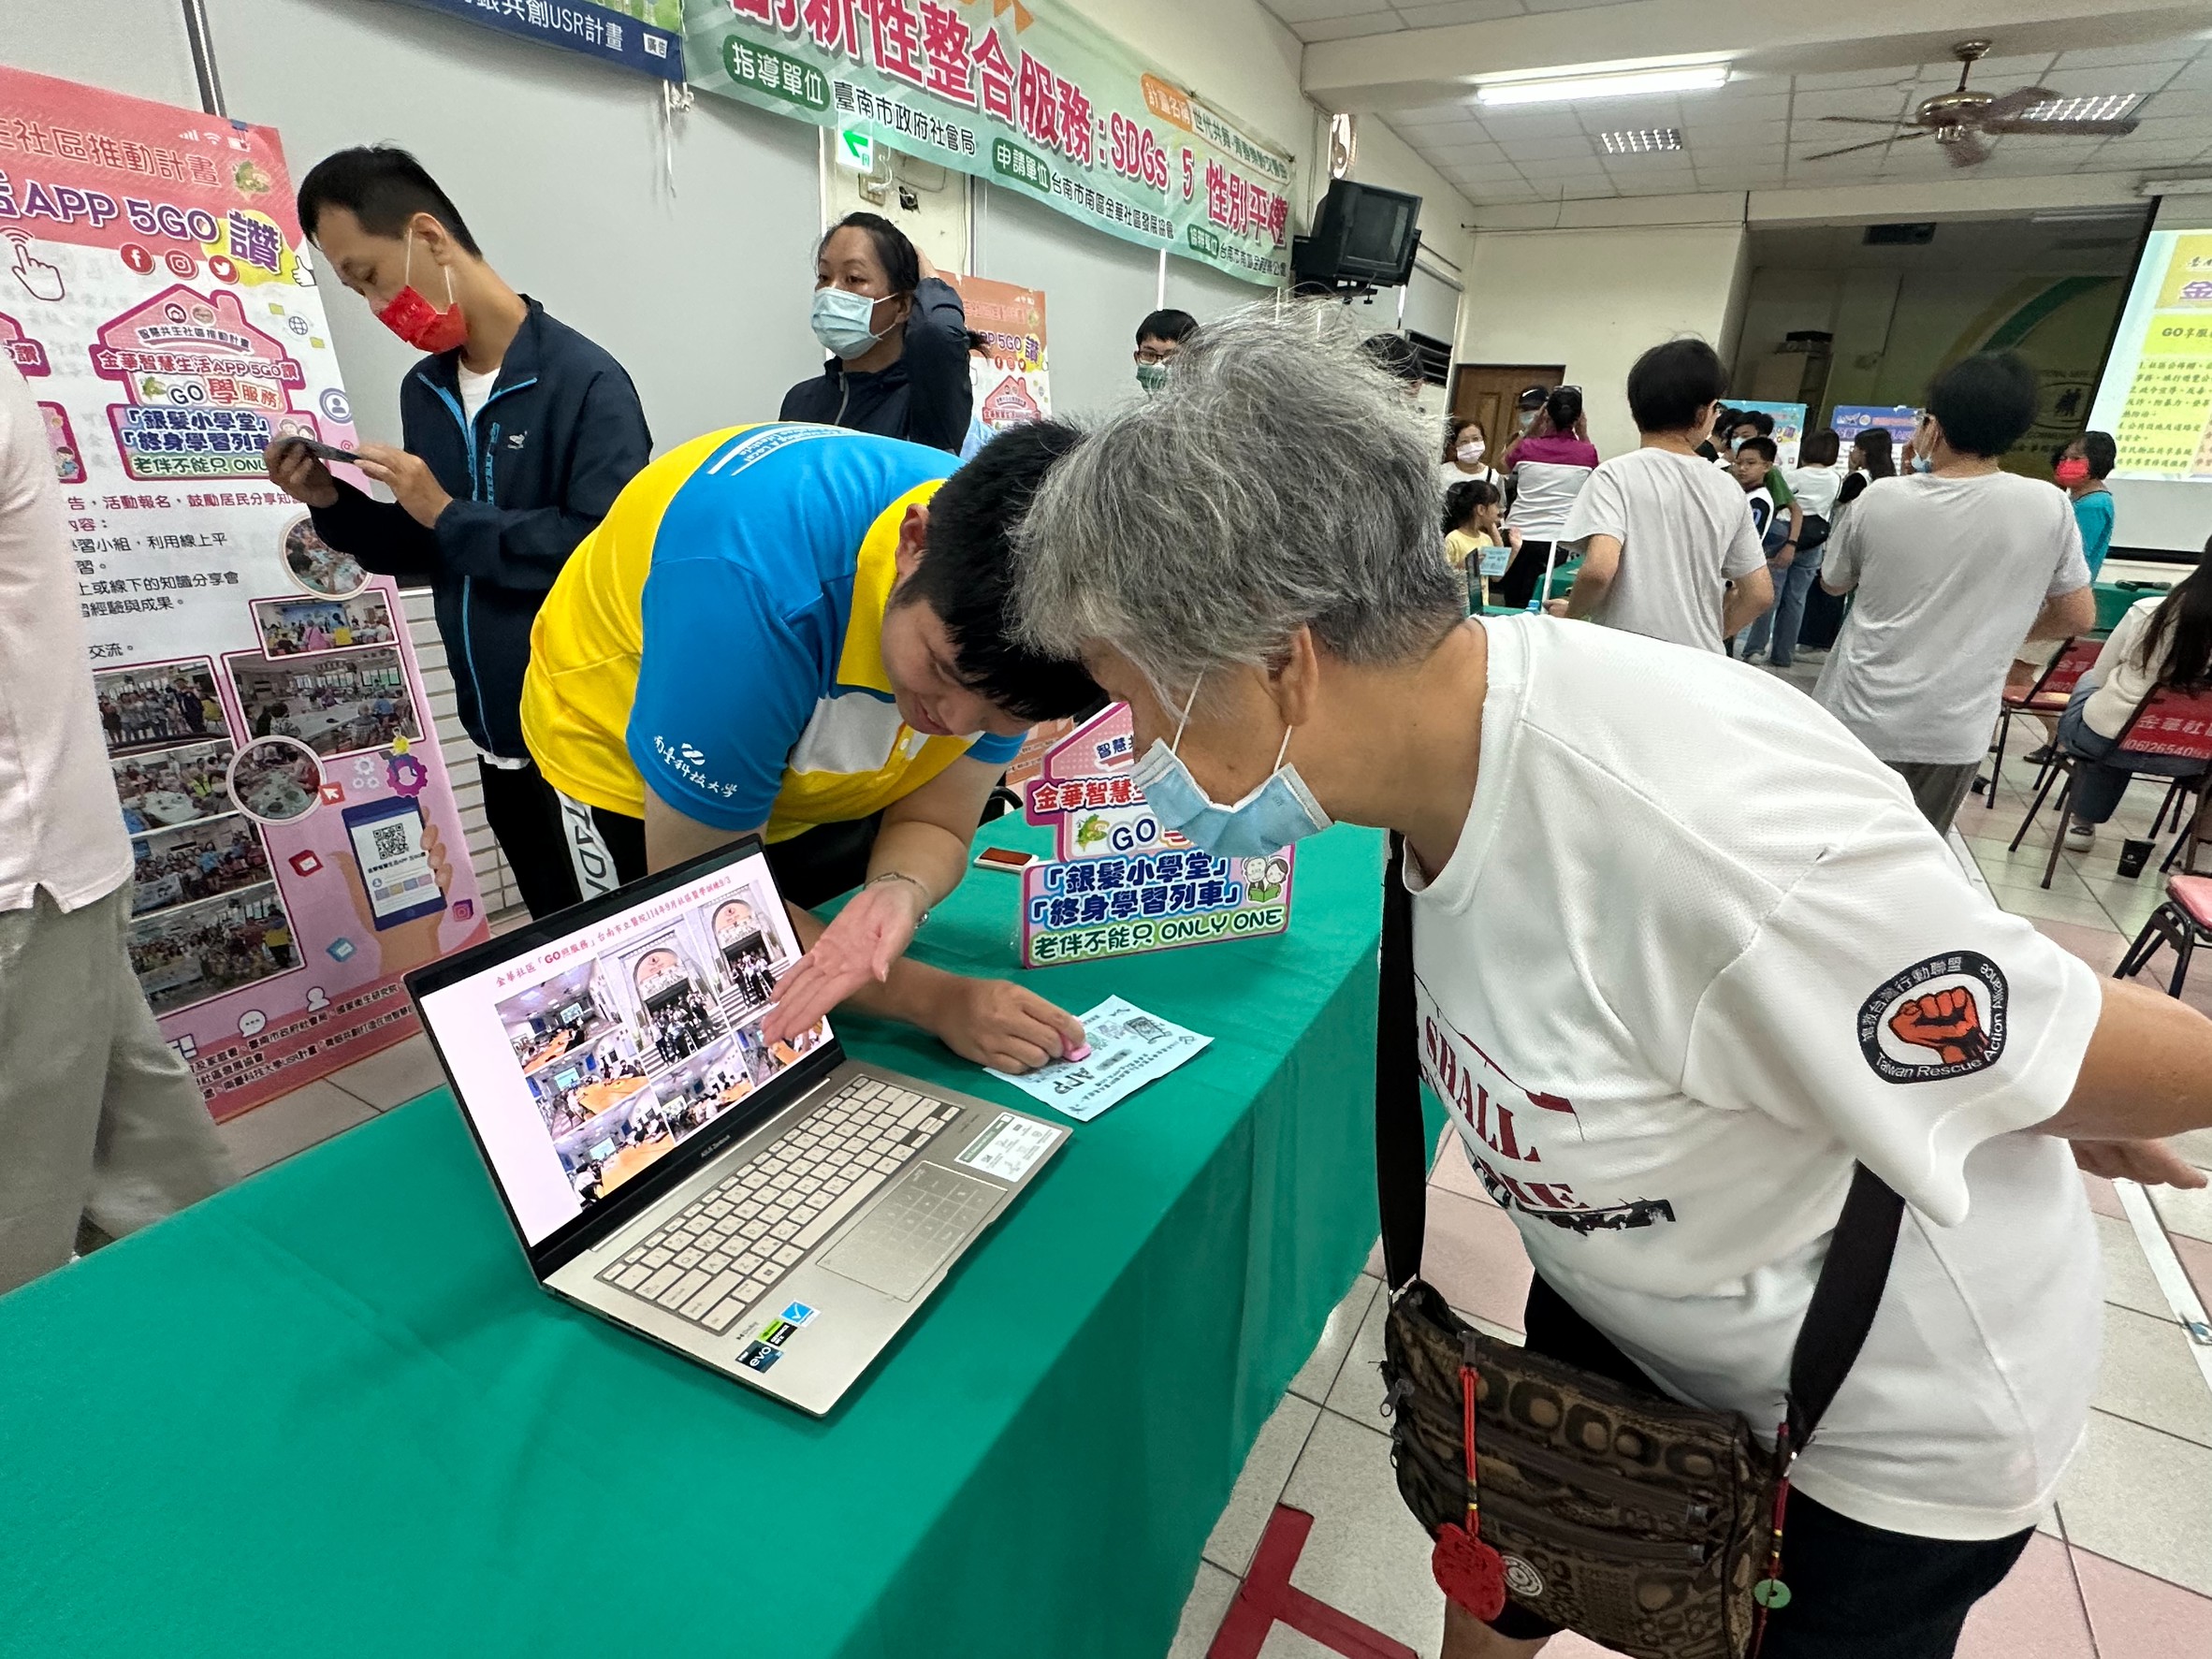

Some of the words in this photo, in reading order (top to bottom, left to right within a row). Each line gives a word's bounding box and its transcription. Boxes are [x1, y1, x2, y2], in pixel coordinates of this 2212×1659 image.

[732, 42, 824, 106] 指導單位
[833, 80, 976, 155] 臺南市政府社會局
[996, 143, 1049, 189] 申請單位
[1182, 147, 1194, 199] 5
[124, 198, 219, 243] 5GO
[228, 211, 283, 275] 讚
[129, 410, 269, 433] 「銀髮小學堂」
[134, 458, 228, 473] 老伴不能只
[80, 571, 240, 596] 上或線下的知識分享會
[1112, 818, 1157, 851] GO
[1047, 851, 1228, 894] 「銀髮小學堂」
[1033, 881, 1241, 926] 「終身學習列車」
[1034, 923, 1155, 959] 老伴不能只
[1161, 915, 1228, 943] ONLY
[1233, 908, 1284, 930] ONE
[1979, 963, 2004, 1009] Alliance
[1984, 1012, 2004, 1062] Action
[1876, 1052, 1914, 1078] Taiwan
[1916, 1058, 1983, 1077] Rescue
[749, 1346, 772, 1367] evo
